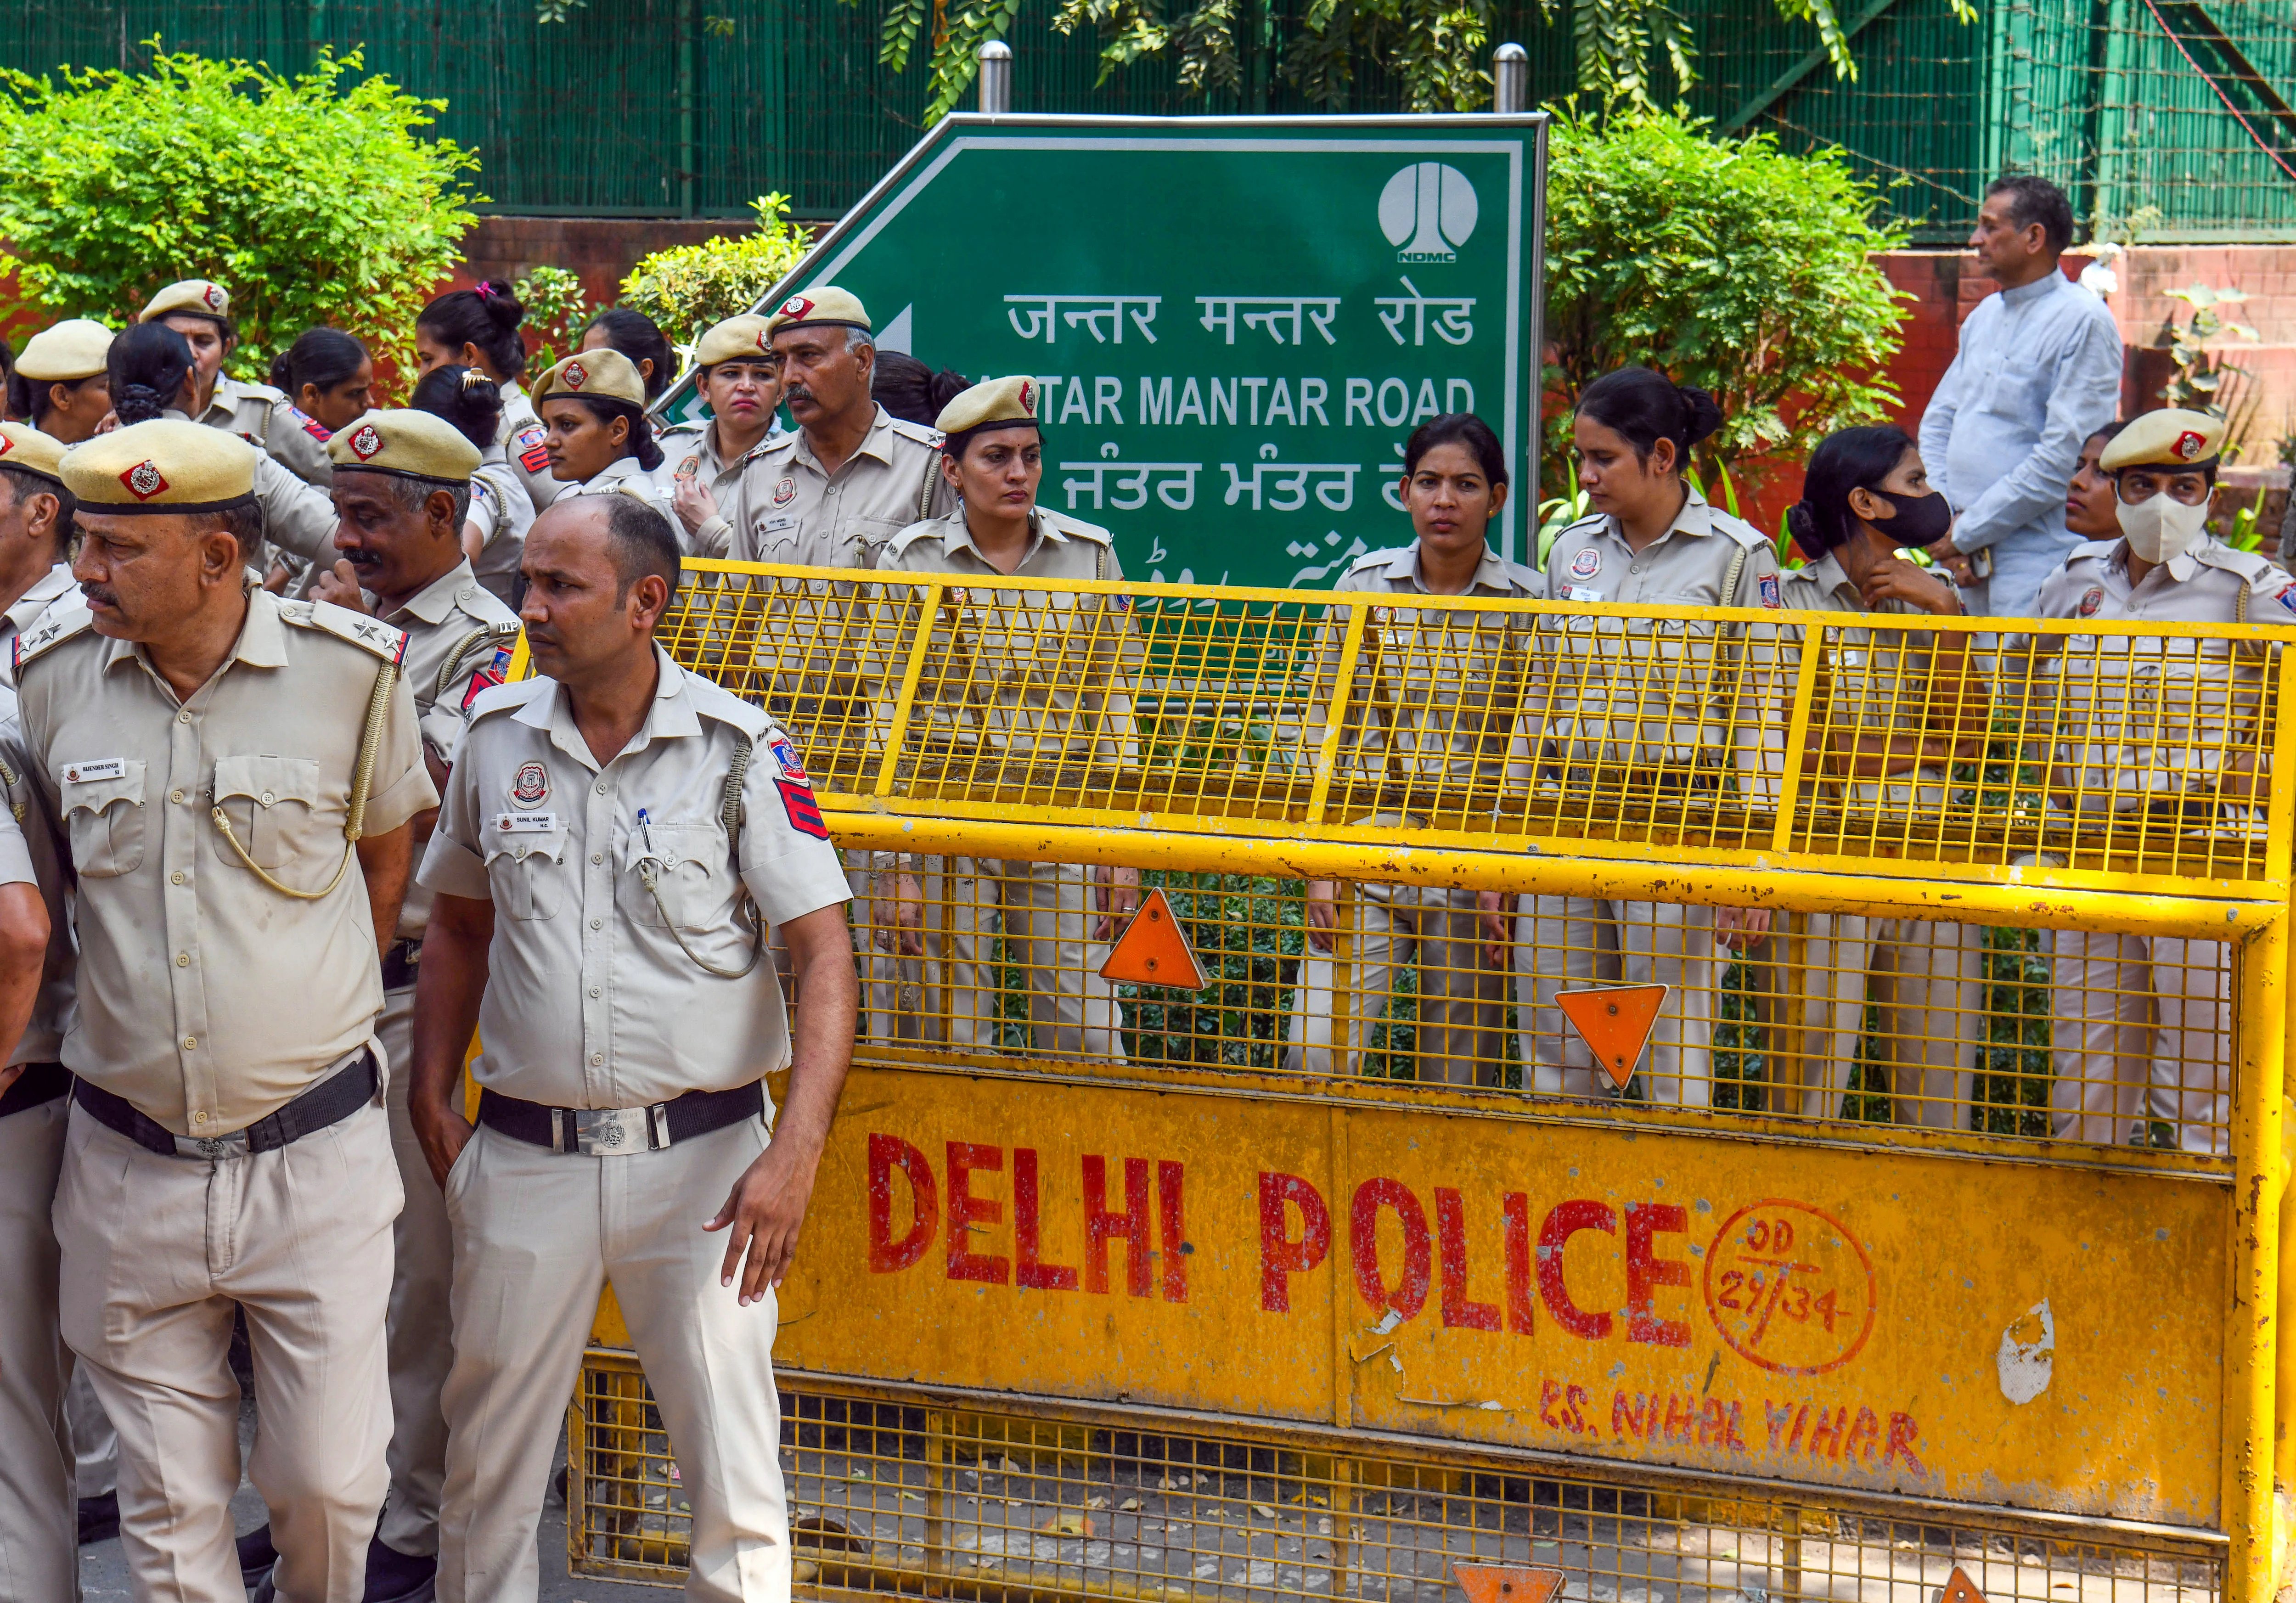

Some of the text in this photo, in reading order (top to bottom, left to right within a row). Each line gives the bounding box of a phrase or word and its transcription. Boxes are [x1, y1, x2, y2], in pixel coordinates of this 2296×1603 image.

[1399, 253, 1456, 262] NDMC
[1004, 276, 1477, 346] जन्तर मन्तर रोड
[1139, 377, 1329, 426] MANTAR
[1346, 377, 1474, 427] ROAD
[1059, 443, 1202, 511] ਜੰਤਰ
[1220, 443, 1361, 511] ਮੰਤਰ
[868, 1132, 1692, 1348] DELHI POLICE
[1611, 1389, 1746, 1452] NIHAL
